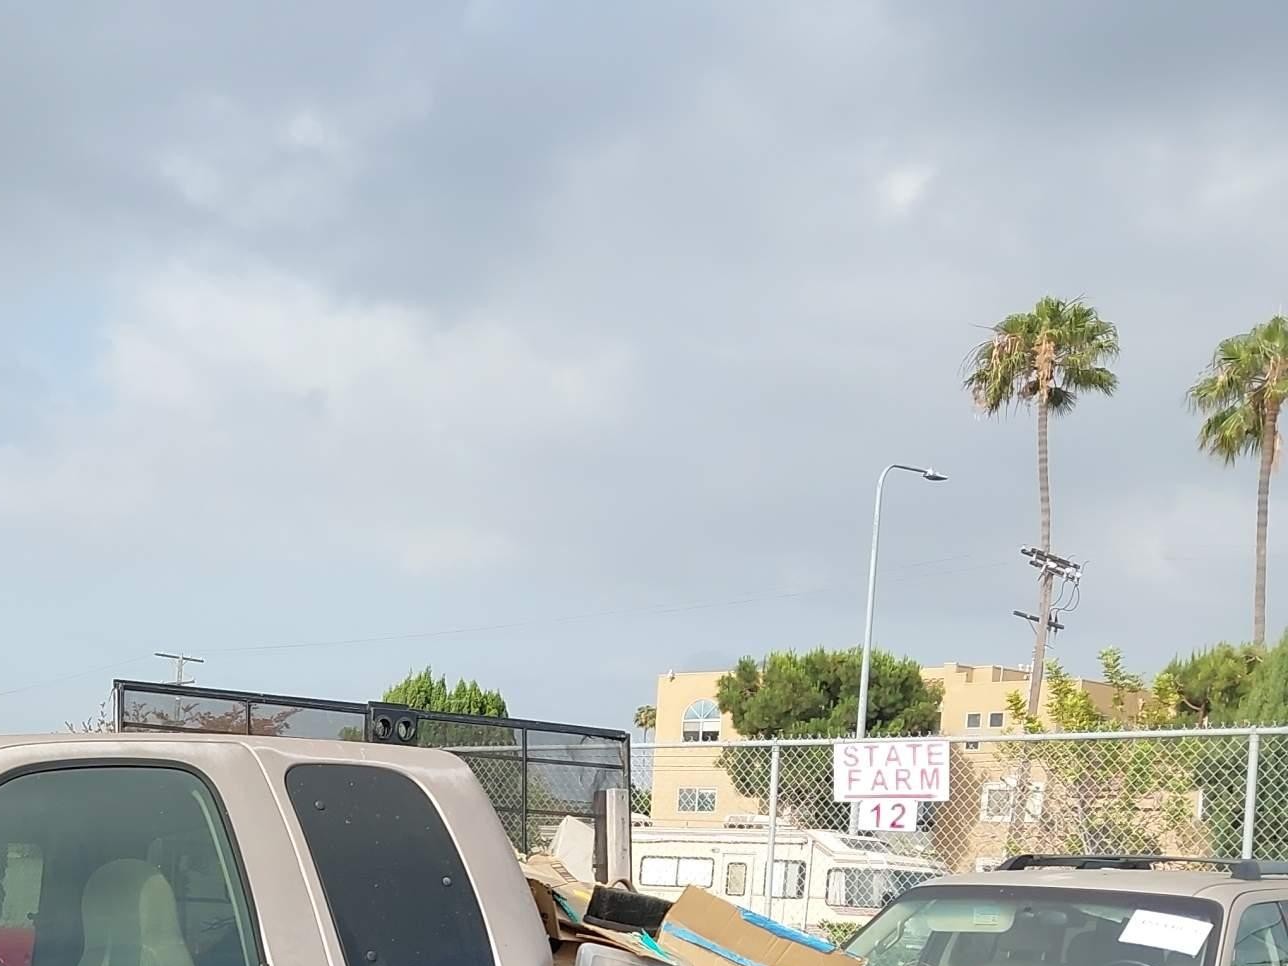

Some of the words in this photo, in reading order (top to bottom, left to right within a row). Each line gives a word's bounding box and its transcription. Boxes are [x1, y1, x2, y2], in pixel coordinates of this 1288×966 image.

[843, 744, 945, 767] STATE
[847, 768, 941, 791] FARM
[871, 803, 906, 828] 12
